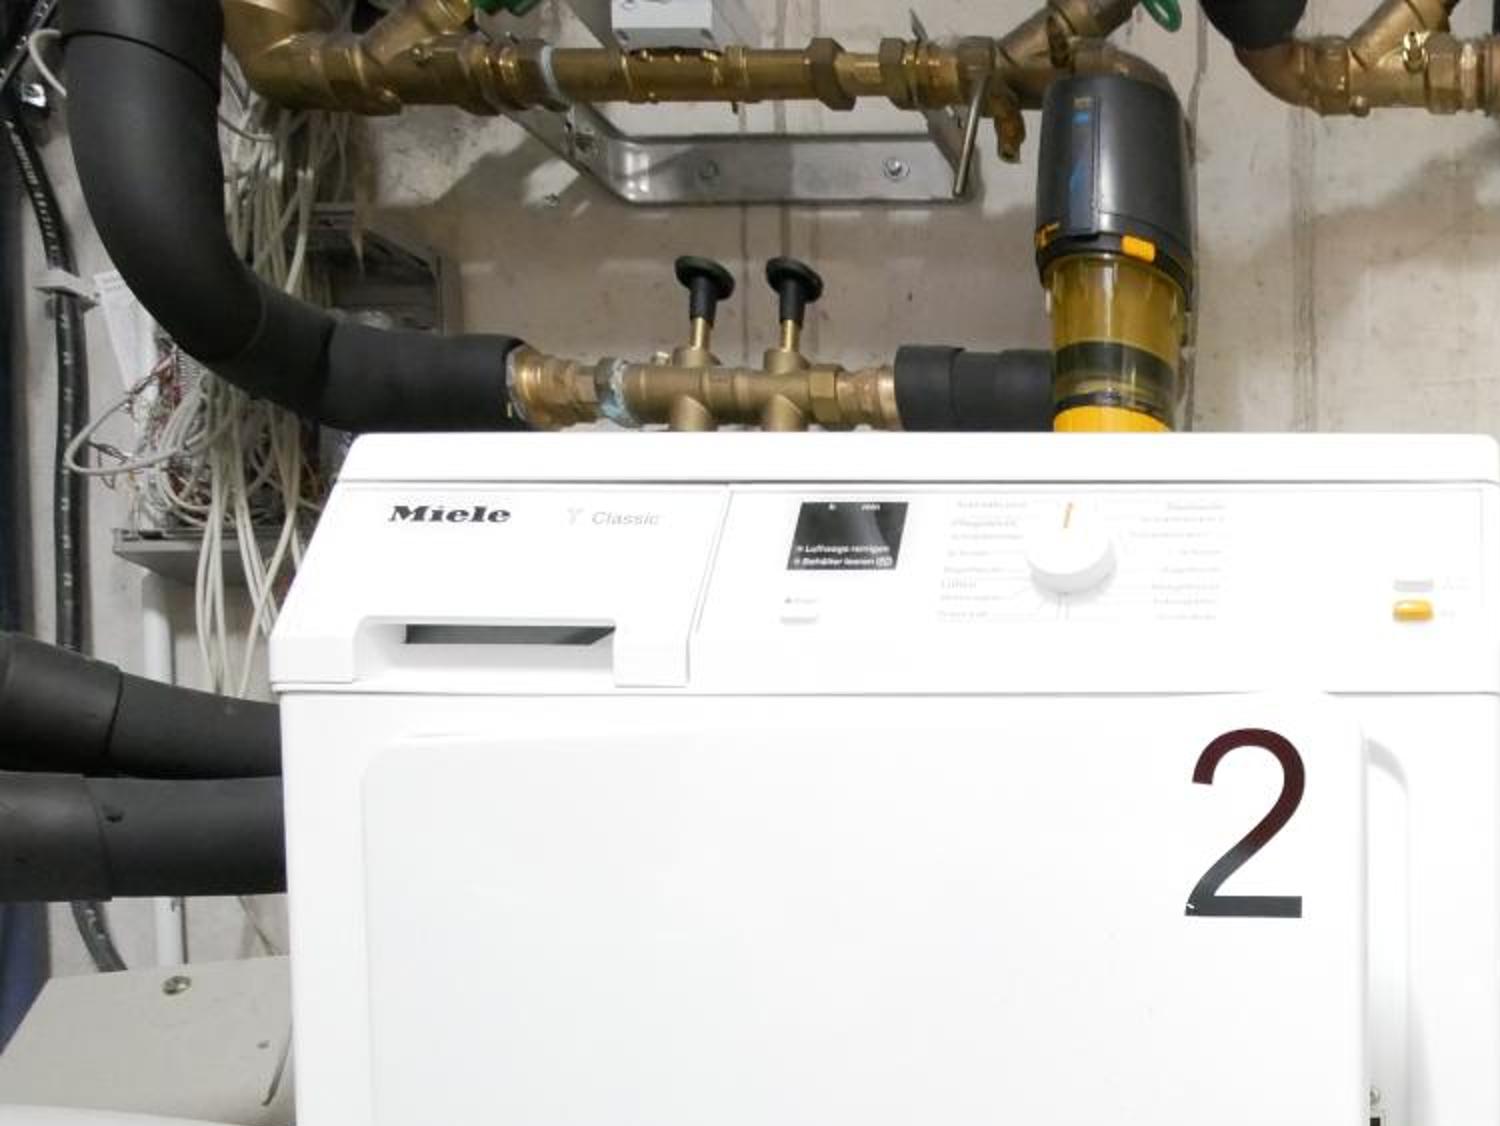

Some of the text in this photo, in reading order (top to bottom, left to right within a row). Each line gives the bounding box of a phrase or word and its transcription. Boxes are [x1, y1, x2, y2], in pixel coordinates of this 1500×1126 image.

[389, 505, 511, 523] Miele
[591, 510, 659, 525] Classic
[1185, 728, 1306, 919] 2
